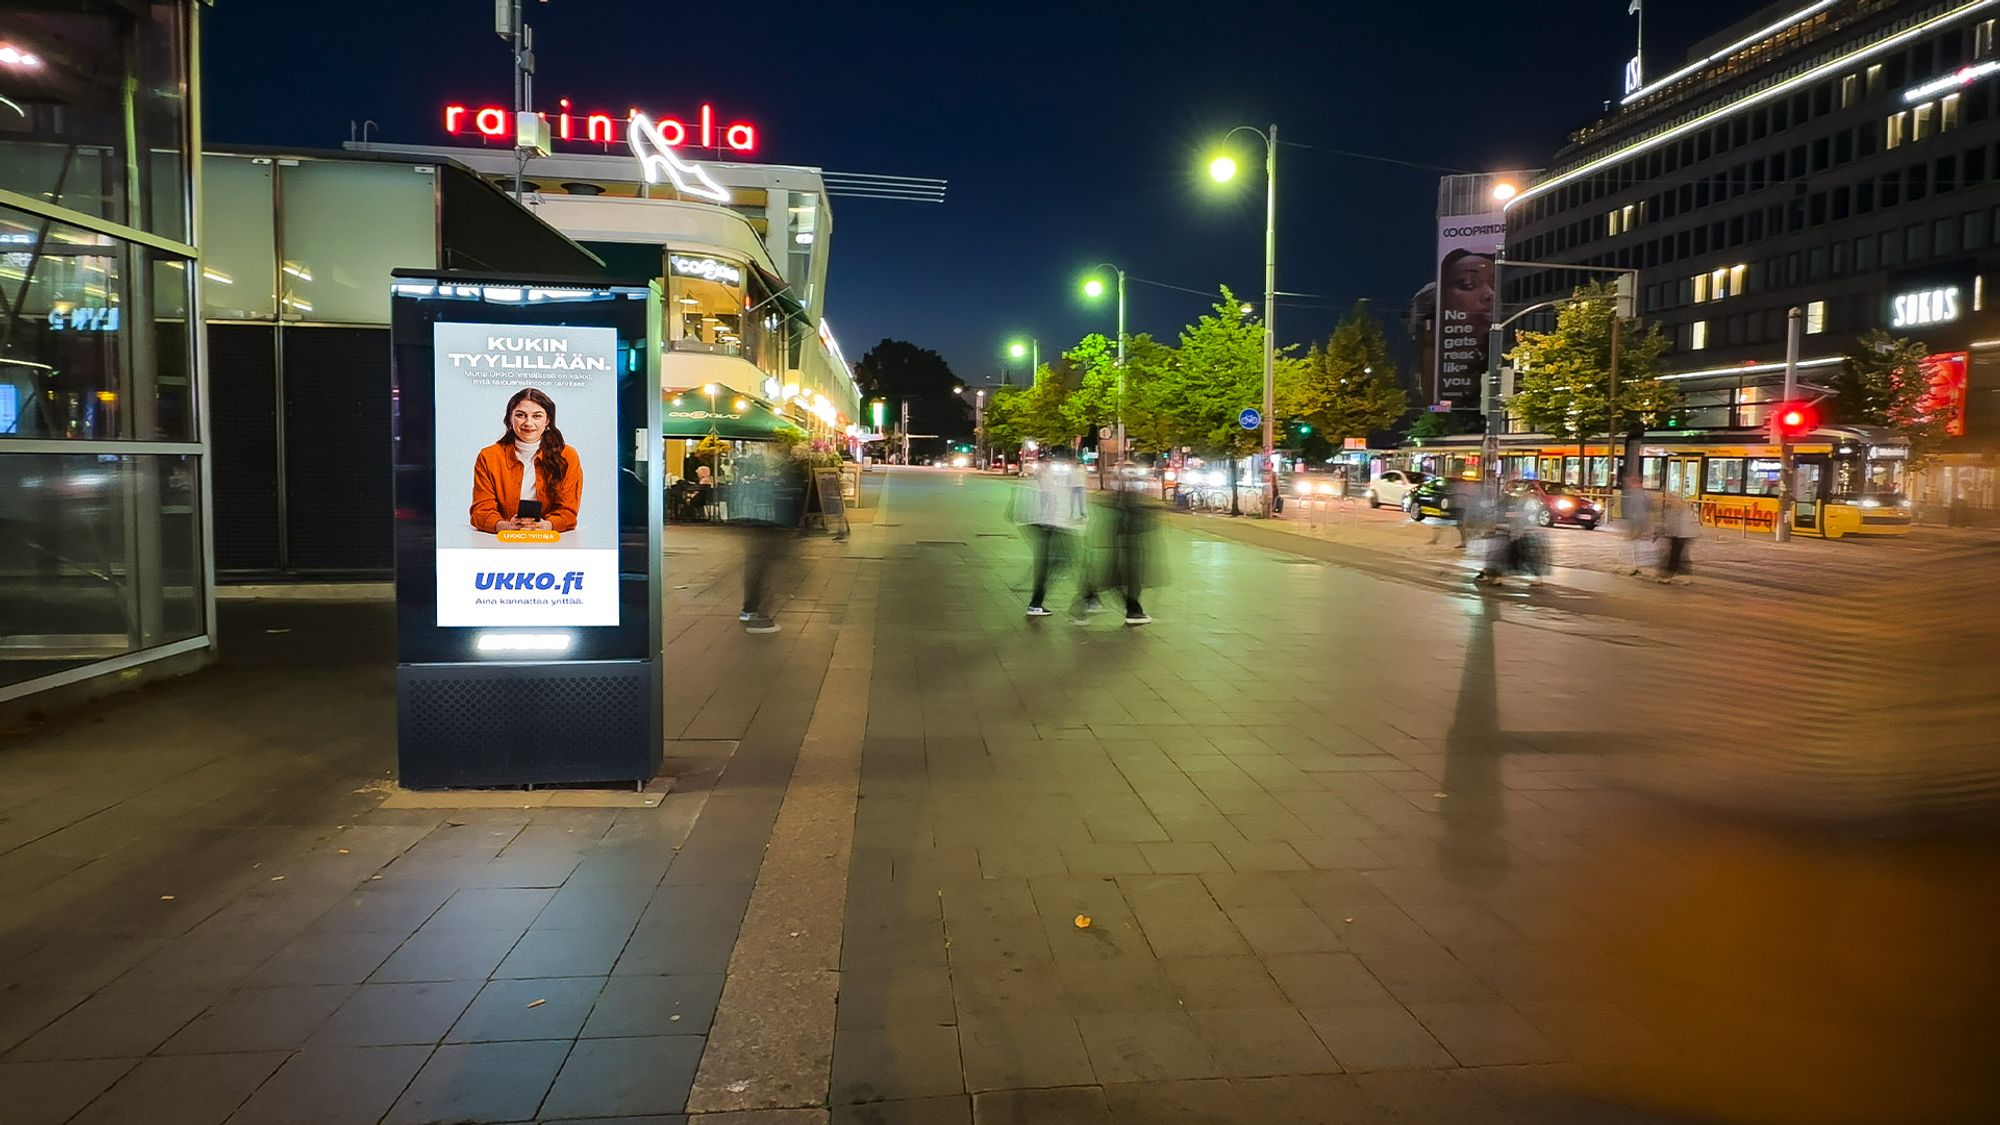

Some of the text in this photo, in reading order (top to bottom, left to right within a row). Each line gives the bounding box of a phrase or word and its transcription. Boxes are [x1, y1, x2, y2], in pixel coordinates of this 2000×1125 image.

[446, 98, 754, 150] rainola
[1444, 309, 1467, 321] No
[1893, 287, 1959, 328] SOKOS
[1444, 324, 1473, 334] one
[487, 336, 568, 352] KUKIN
[1444, 336, 1478, 349] gets
[448, 353, 612, 371] TYYLILLÄÄN.
[1443, 377, 1472, 388] you
[475, 571, 585, 594] UKKO.fi
